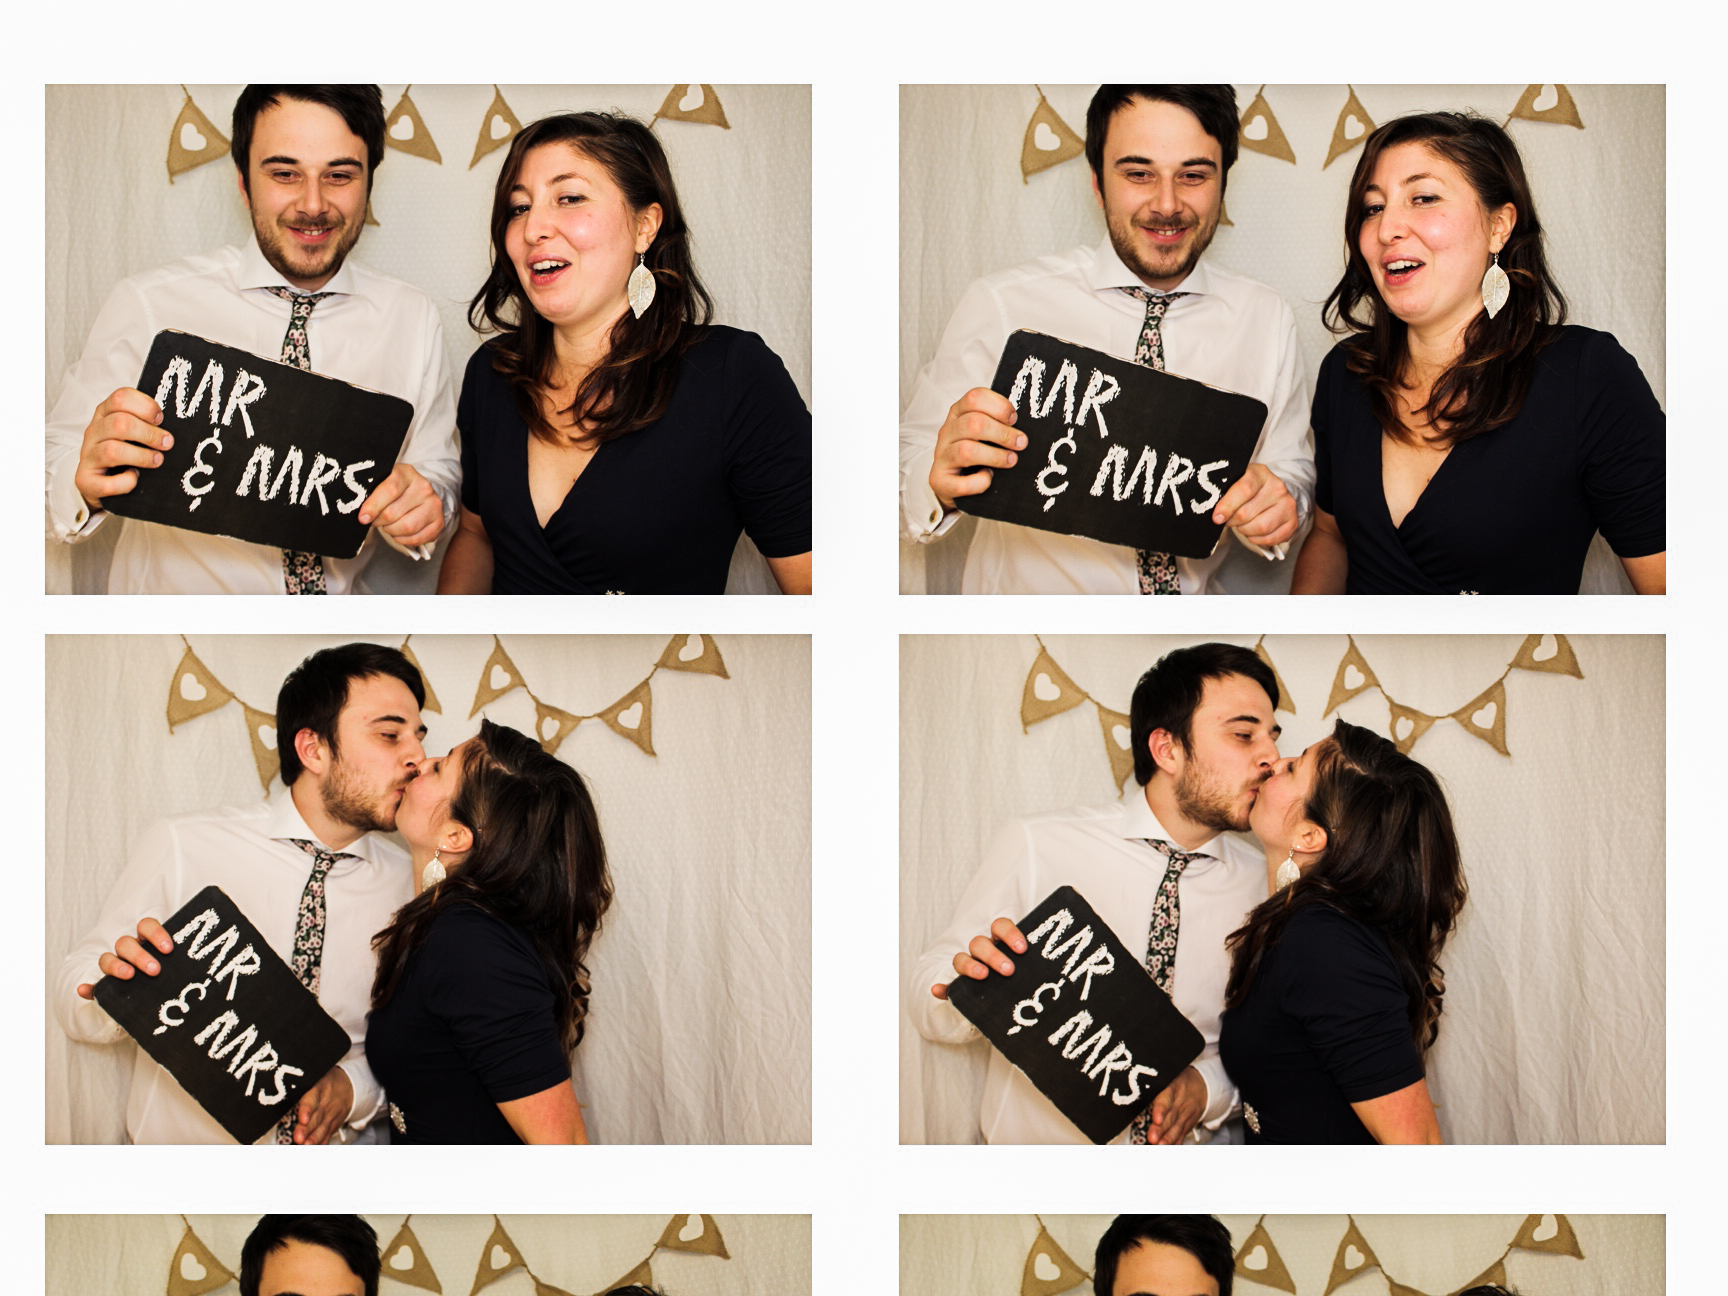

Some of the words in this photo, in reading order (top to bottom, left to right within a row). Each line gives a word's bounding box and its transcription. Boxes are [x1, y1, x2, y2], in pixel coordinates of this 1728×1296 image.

[154, 355, 267, 438] MR
[1008, 355, 1121, 438] MR
[181, 427, 223, 512] &
[235, 443, 375, 516] MRS
[1035, 427, 1077, 512] &
[1089, 443, 1229, 516] MRS
[172, 908, 261, 1001] MR
[1026, 908, 1115, 1001] MR
[152, 977, 211, 1036] &
[194, 1009, 304, 1106] MRS
[1006, 977, 1065, 1036] &
[1048, 1009, 1158, 1106] MRS
